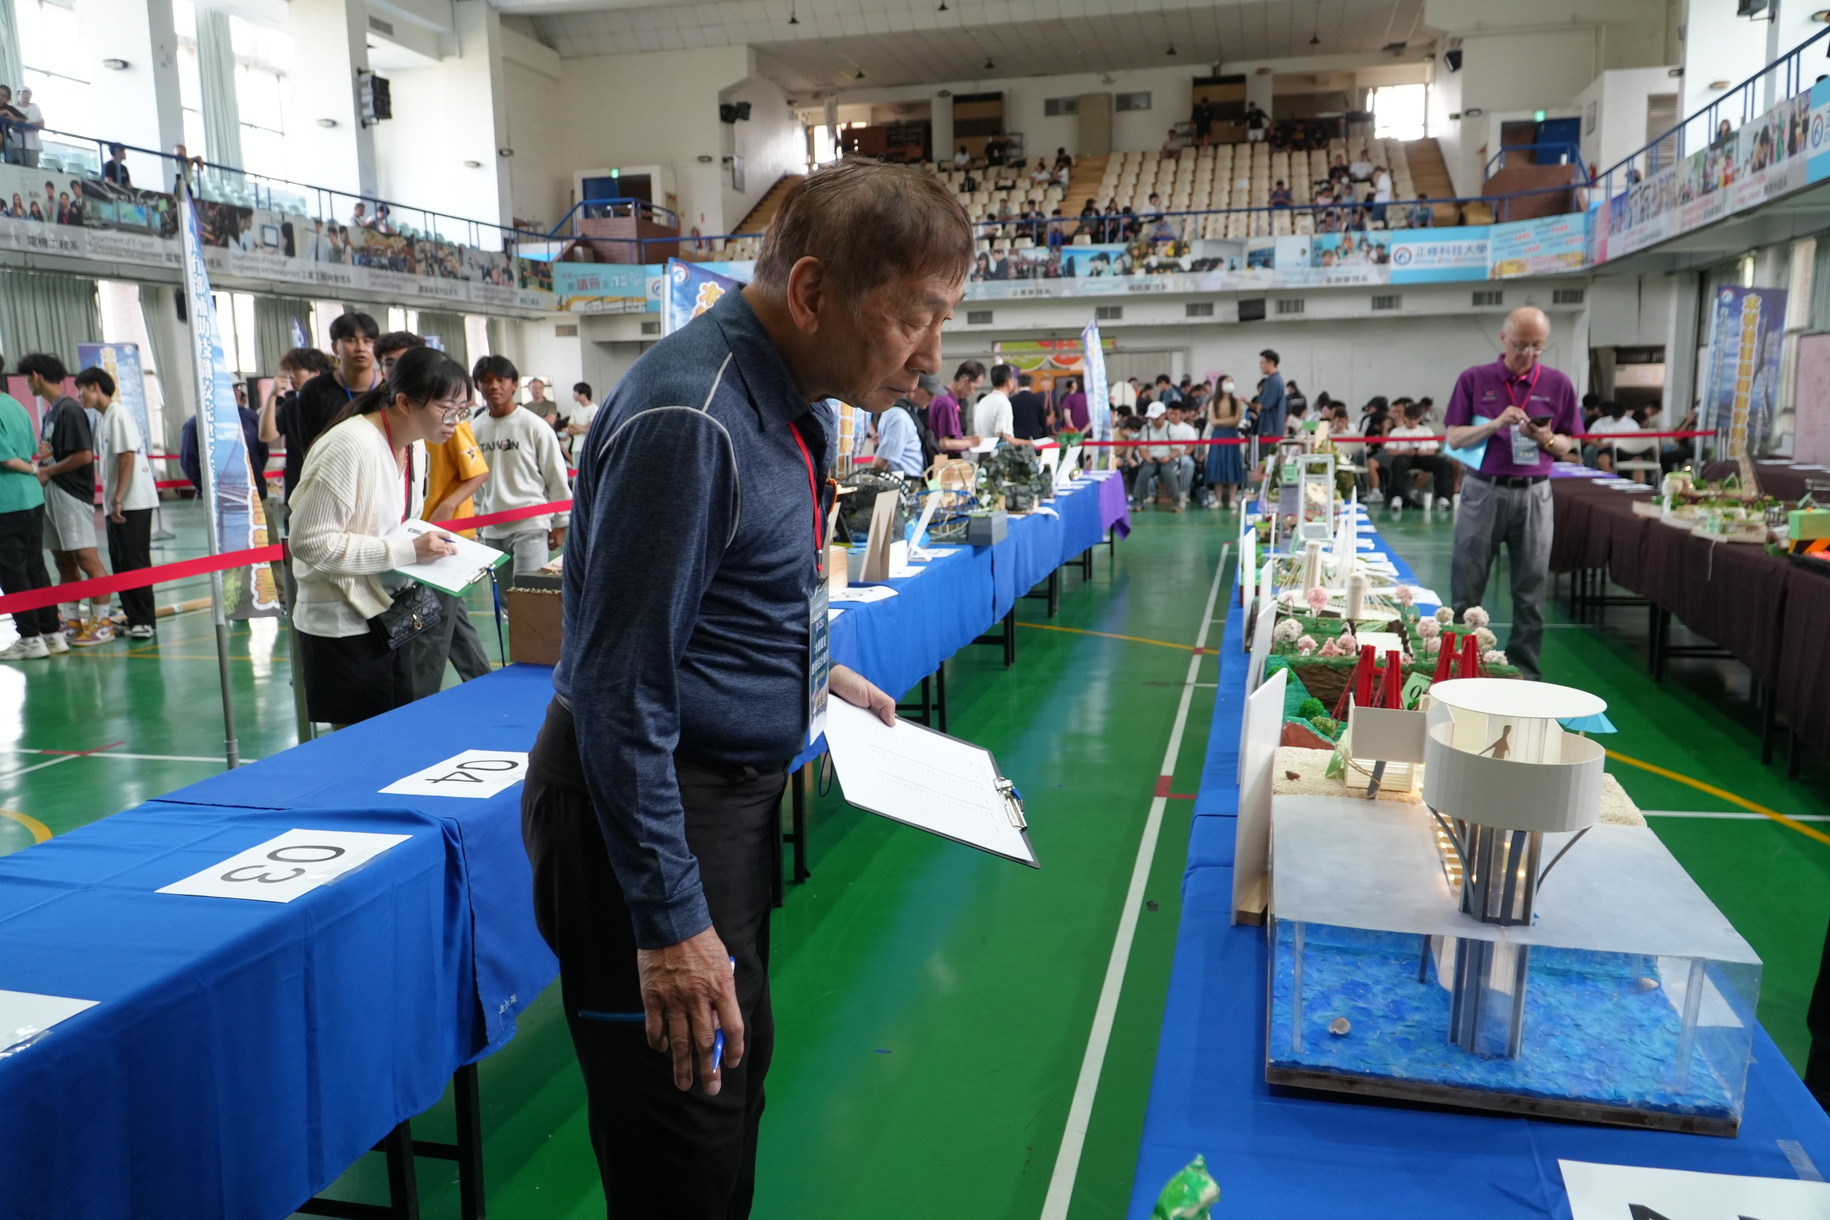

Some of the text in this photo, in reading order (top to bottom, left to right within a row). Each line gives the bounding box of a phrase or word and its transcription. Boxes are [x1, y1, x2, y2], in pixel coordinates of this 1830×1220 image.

[1416, 243, 1487, 257] 正修科技大學
[423, 758, 519, 784] 04
[220, 844, 347, 885] 03
